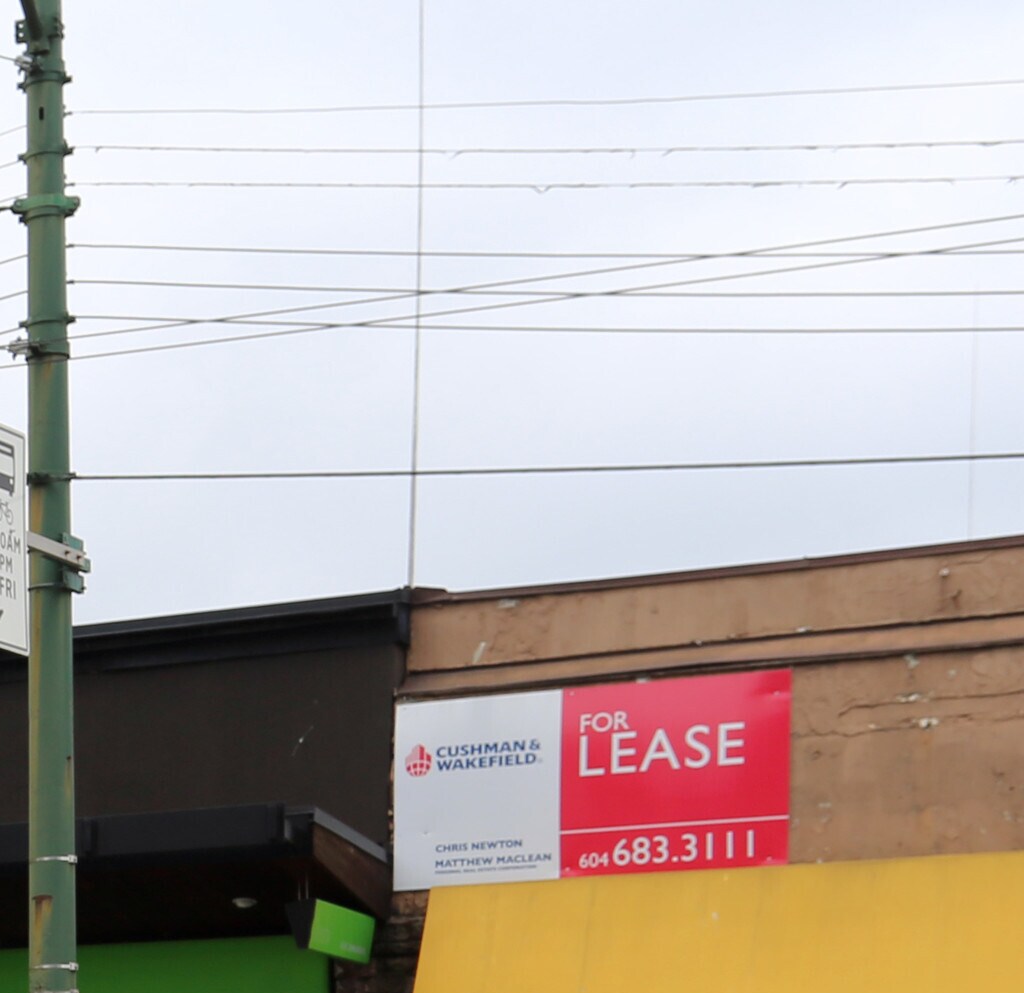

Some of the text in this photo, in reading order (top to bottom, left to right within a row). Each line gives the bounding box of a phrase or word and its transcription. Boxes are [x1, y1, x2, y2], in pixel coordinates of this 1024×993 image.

[579, 711, 630, 734] FOR
[436, 738, 541, 758] CUSHMAN &
[578, 721, 746, 778] LEASE
[436, 753, 537, 772] WAKEFIELD
[435, 839, 523, 853] CHRIS NEWTON
[578, 829, 755, 869] 604 683.3111
[435, 853, 552, 868] MATTHEW MACLEAN
